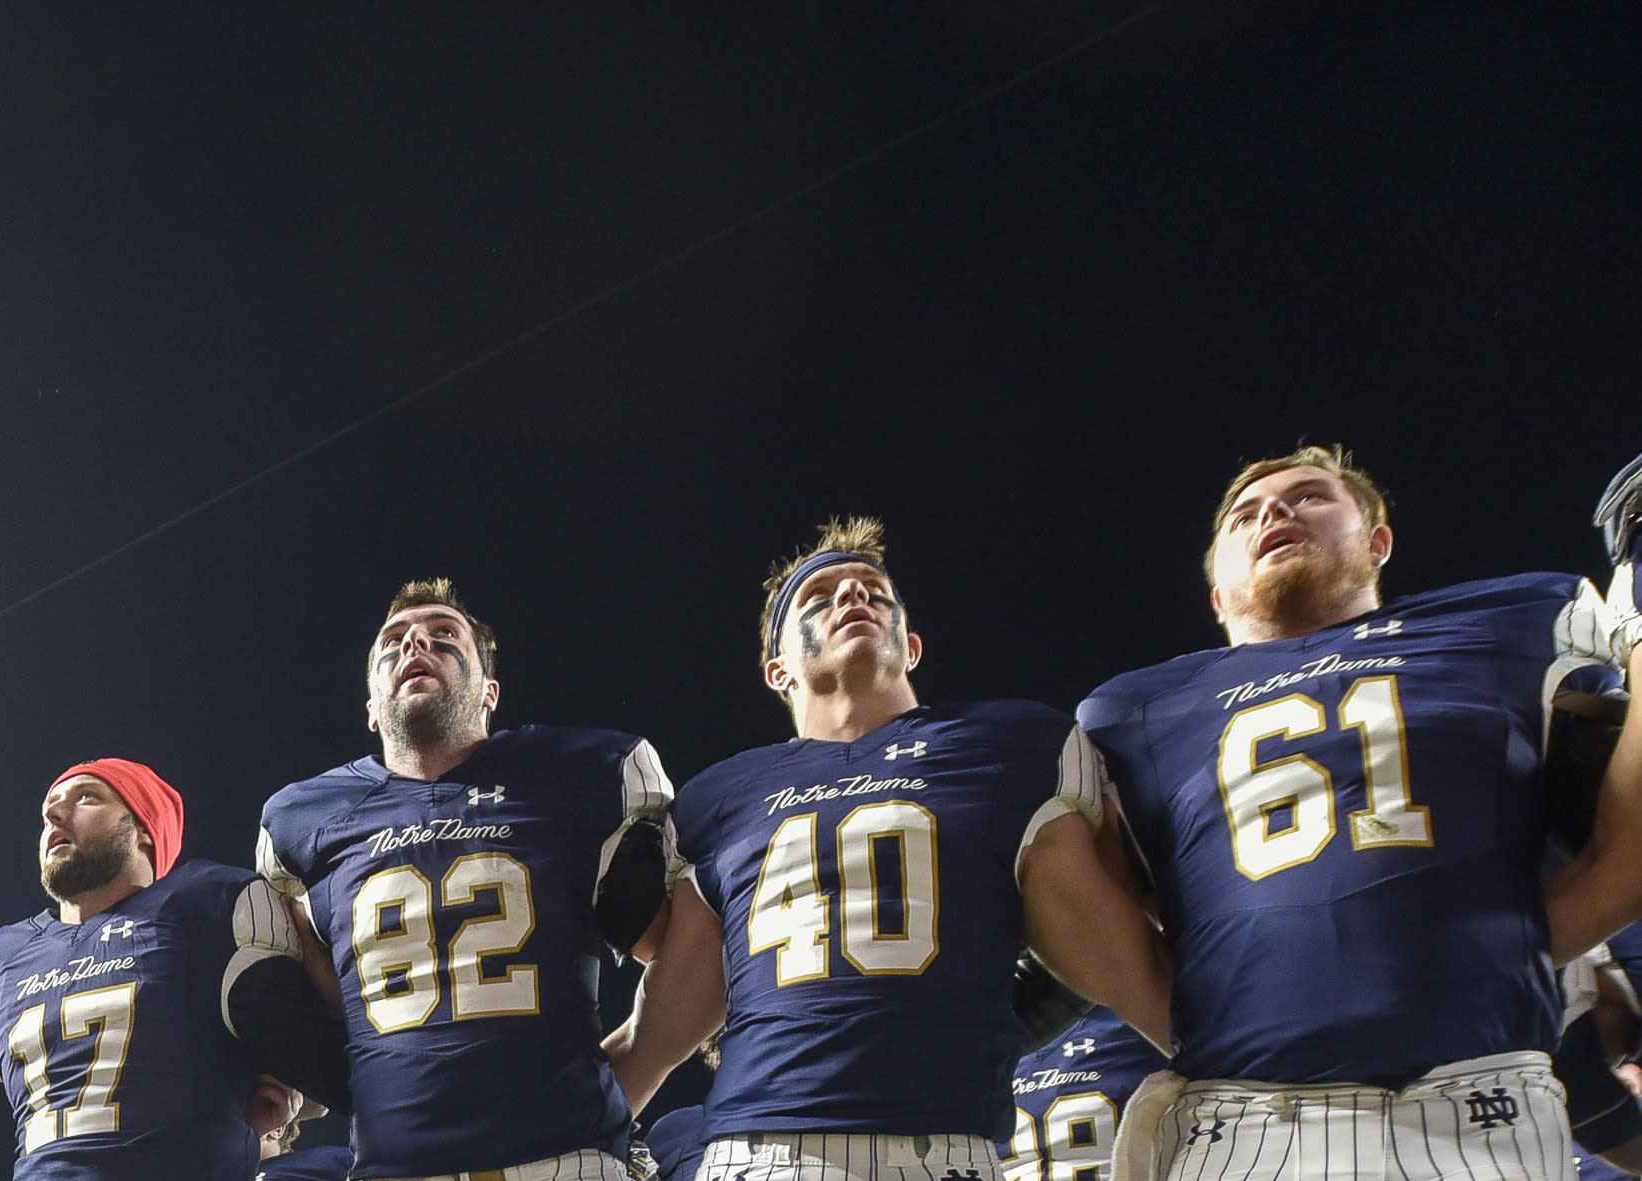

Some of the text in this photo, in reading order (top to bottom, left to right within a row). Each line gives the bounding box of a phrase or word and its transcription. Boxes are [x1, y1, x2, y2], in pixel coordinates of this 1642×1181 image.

[1216, 653, 1406, 710] Notre Dame
[765, 774, 929, 817] Notre Dame
[1217, 673, 1435, 882] 61
[366, 818, 514, 859] Notre Dame
[747, 798, 940, 988] 40
[351, 851, 541, 1035] 82
[16, 953, 136, 1001] Notre Dame
[7, 981, 139, 1157] 17
[1032, 1067, 1102, 1090] Dame
[1465, 1087, 1520, 1129] ND
